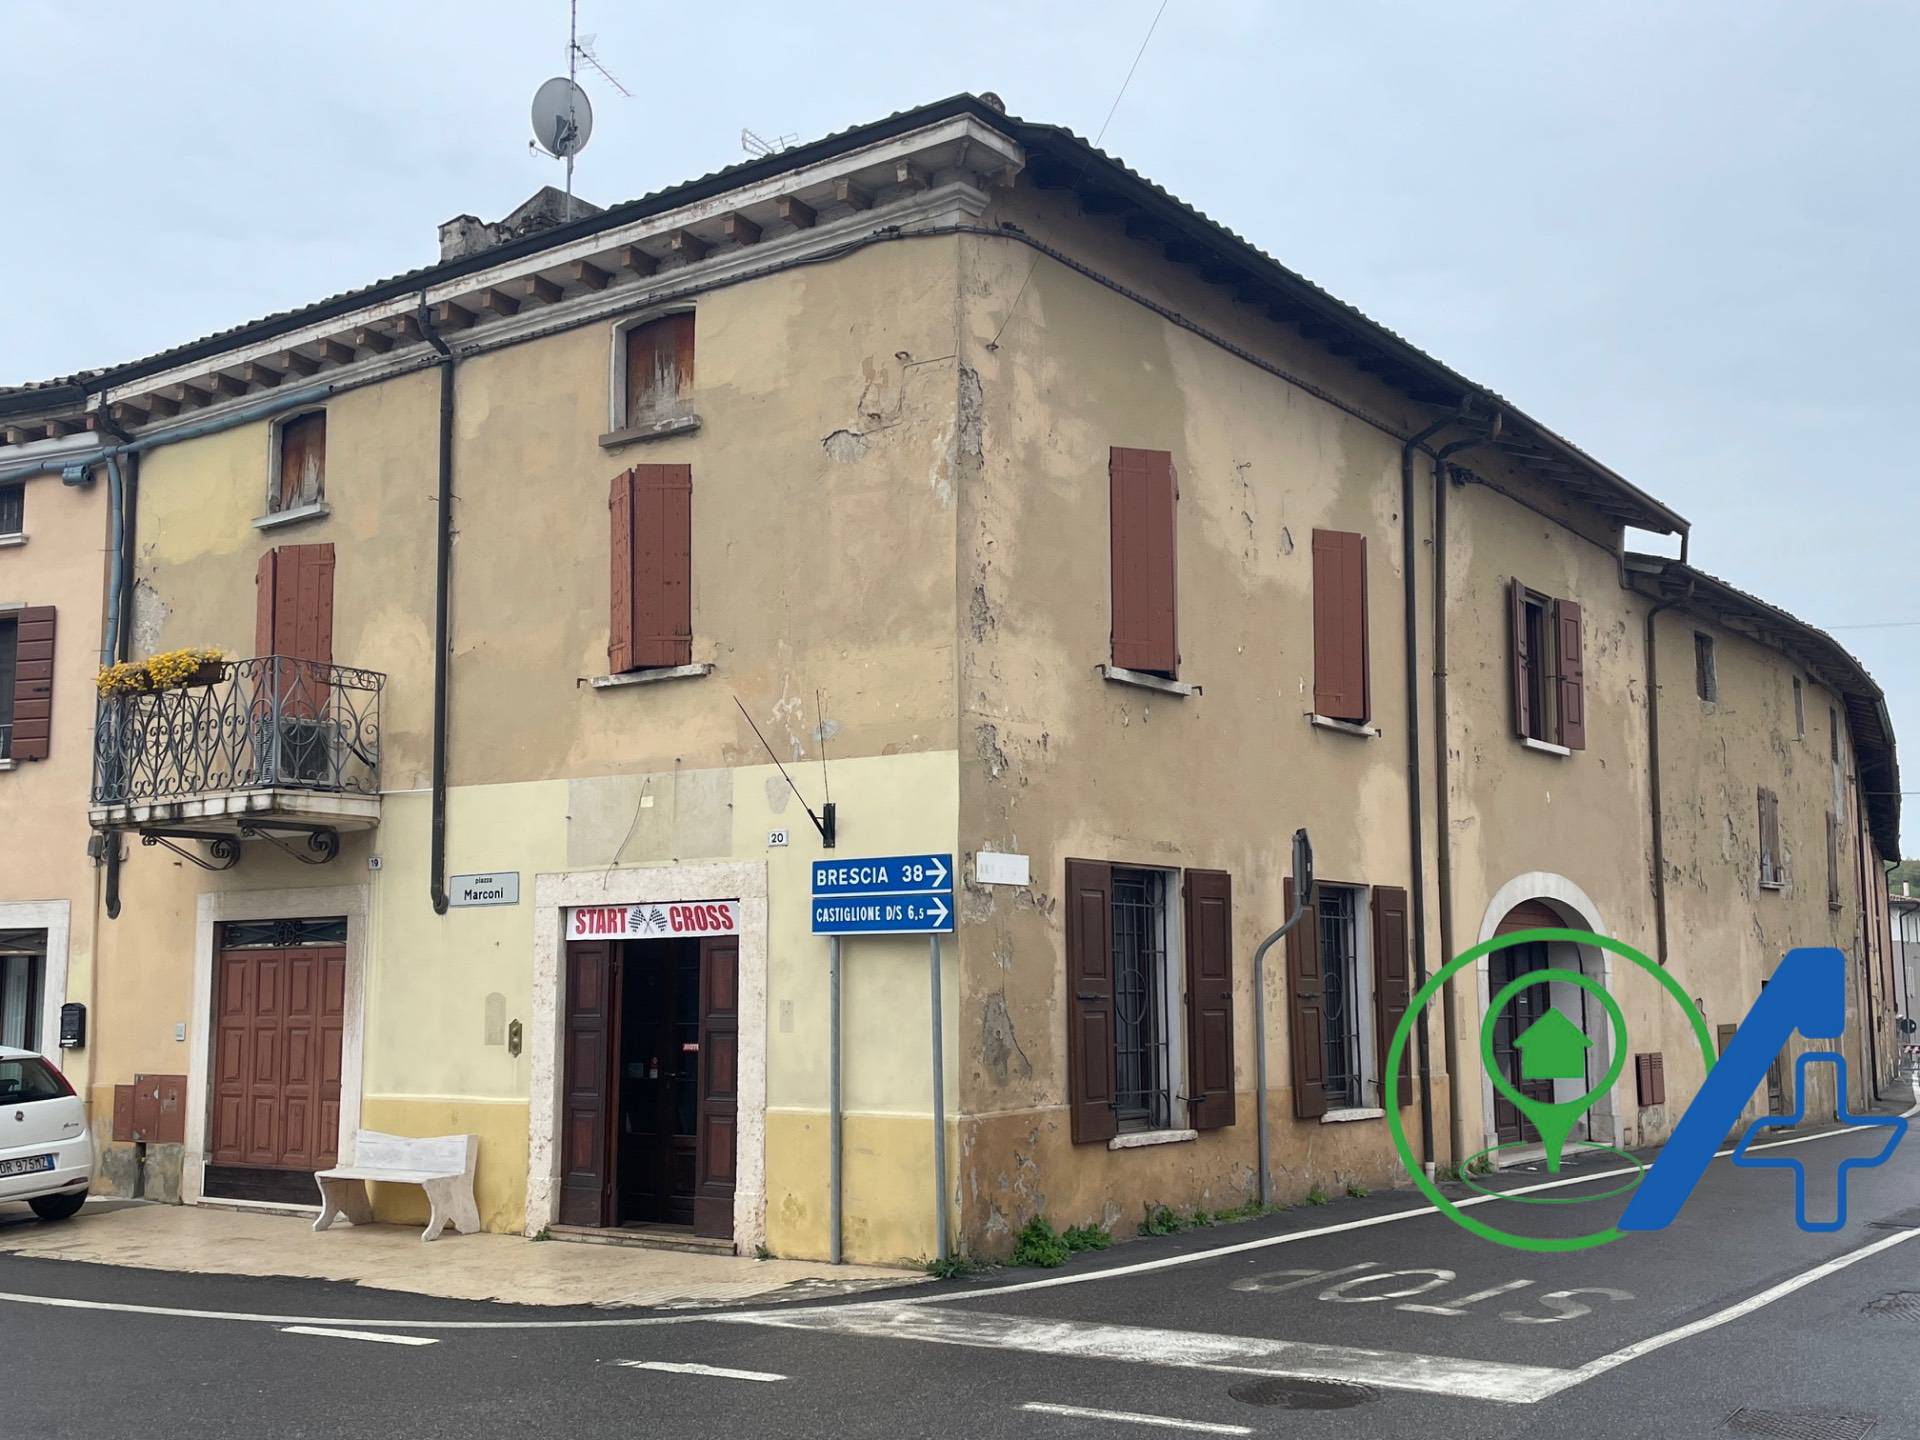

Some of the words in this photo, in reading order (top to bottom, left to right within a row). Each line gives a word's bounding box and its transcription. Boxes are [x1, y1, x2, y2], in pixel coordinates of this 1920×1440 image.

[770, 832, 784, 843] 20
[370, 858, 379, 868] 19
[474, 876, 493, 885] piazza
[816, 866, 889, 887] BRESCIA
[902, 864, 924, 883] 38
[463, 887, 504, 901] Marconi
[575, 907, 628, 935] START
[669, 904, 735, 933] CROSS
[816, 906, 881, 922] CASTIGLIONE
[886, 904, 903, 921] D/S
[1226, 1261, 1637, 1325] STOP
